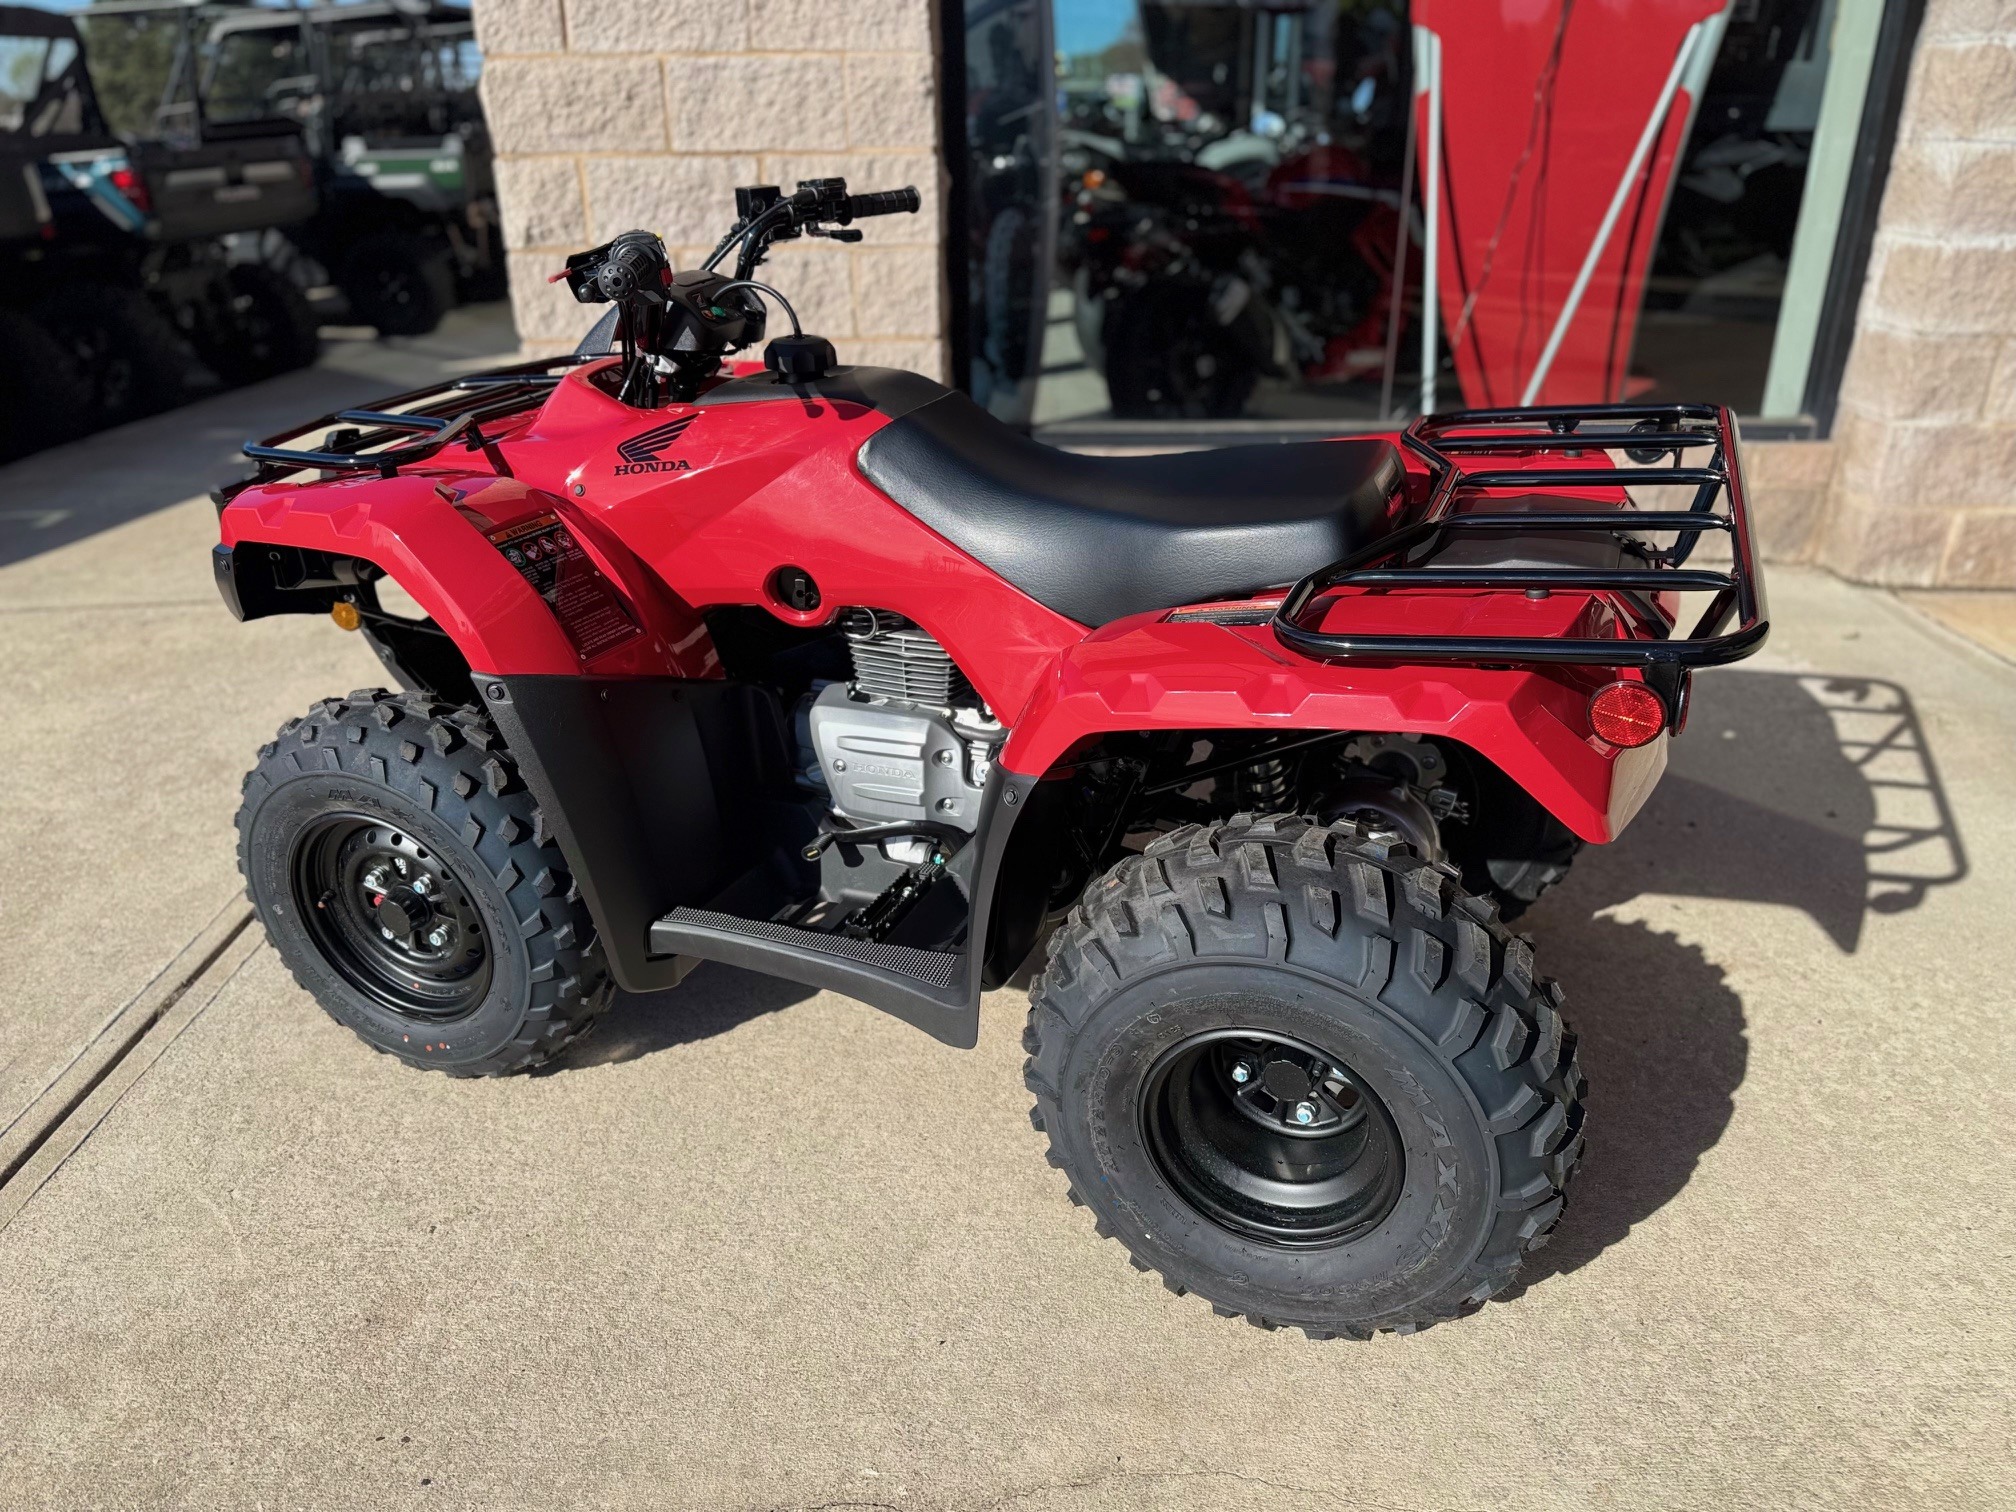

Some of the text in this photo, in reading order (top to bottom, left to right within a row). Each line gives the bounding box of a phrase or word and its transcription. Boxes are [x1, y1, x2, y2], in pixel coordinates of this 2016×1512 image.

[614, 460, 692, 476] HONDA
[512, 520, 543, 536] WARNING
[853, 762, 917, 779] HONDA
[1384, 1066, 1460, 1275] MAXXIS
